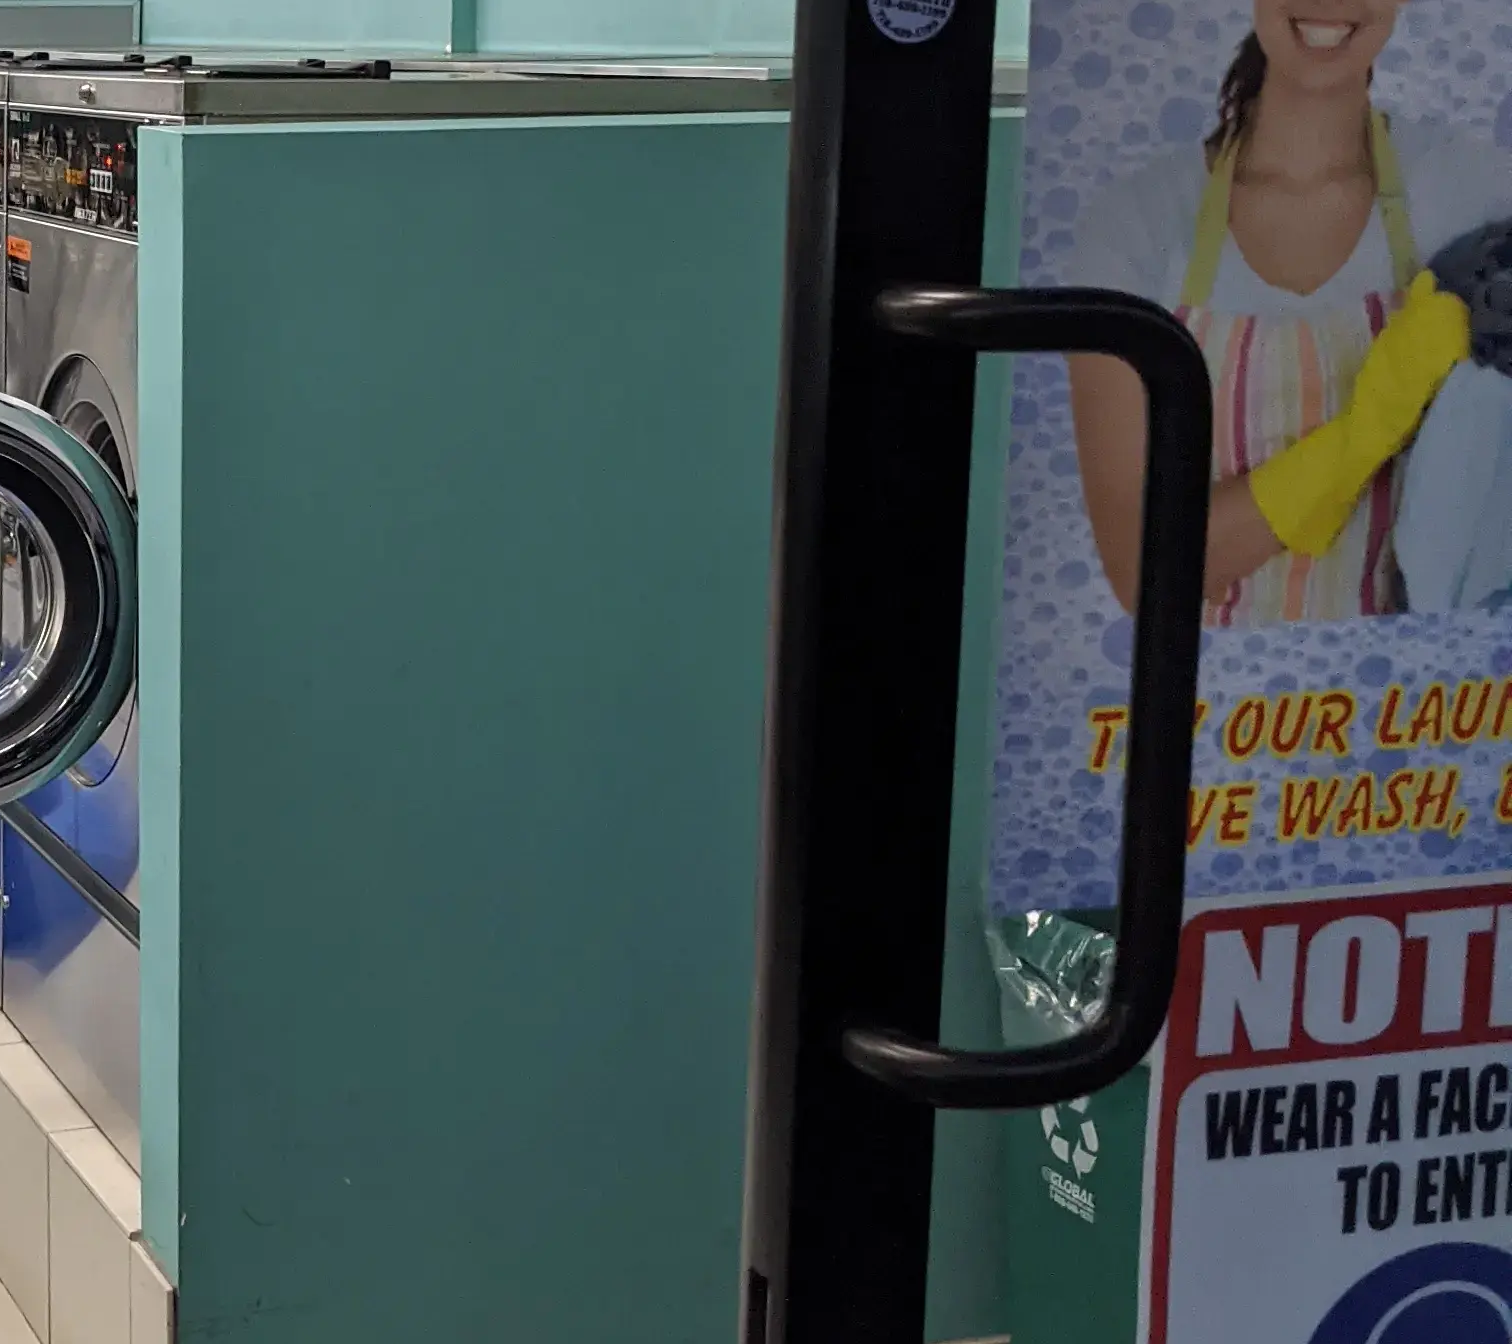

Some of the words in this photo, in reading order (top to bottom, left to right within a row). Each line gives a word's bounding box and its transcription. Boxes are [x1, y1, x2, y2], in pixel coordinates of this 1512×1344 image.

[1227, 693, 1355, 757] OUR
[1281, 767, 1467, 838] WASH,
[1206, 1079, 1358, 1161] WEAR
[1365, 1073, 1401, 1145] A
[1413, 1061, 1512, 1141] FAC
[1337, 1159, 1401, 1235] TO
[1412, 1149, 1512, 1227] ENT
